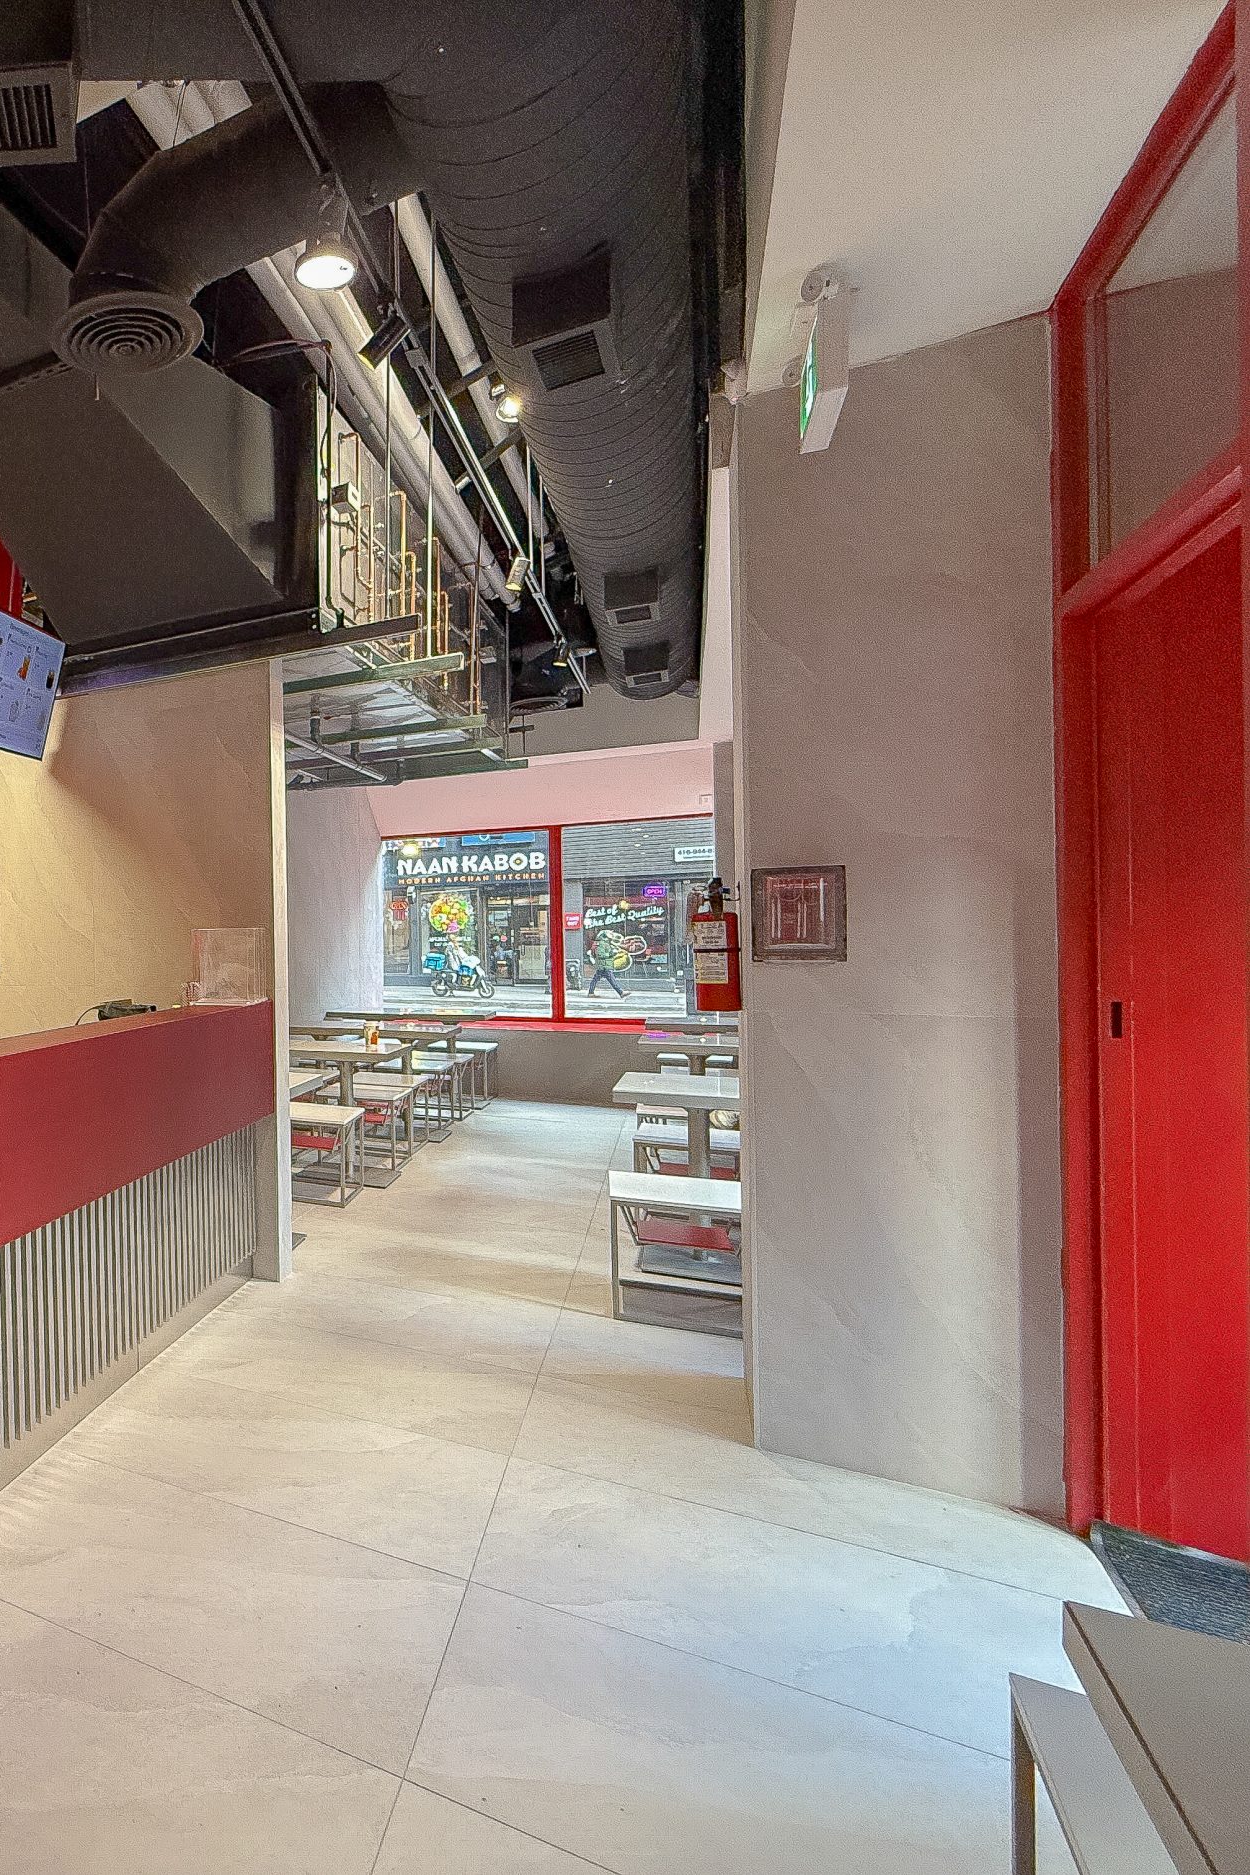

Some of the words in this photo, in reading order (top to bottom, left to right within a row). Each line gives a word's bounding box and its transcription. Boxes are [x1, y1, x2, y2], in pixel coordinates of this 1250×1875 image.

[396, 856, 459, 876] NAAN
[461, 851, 546, 873] KABOB
[398, 877, 441, 885] MODERN
[445, 875, 490, 883] AFGHAN
[494, 872, 546, 881] KITCHEN
[585, 907, 607, 918] Best
[605, 912, 627, 924] Best
[626, 905, 666, 921] Quality
